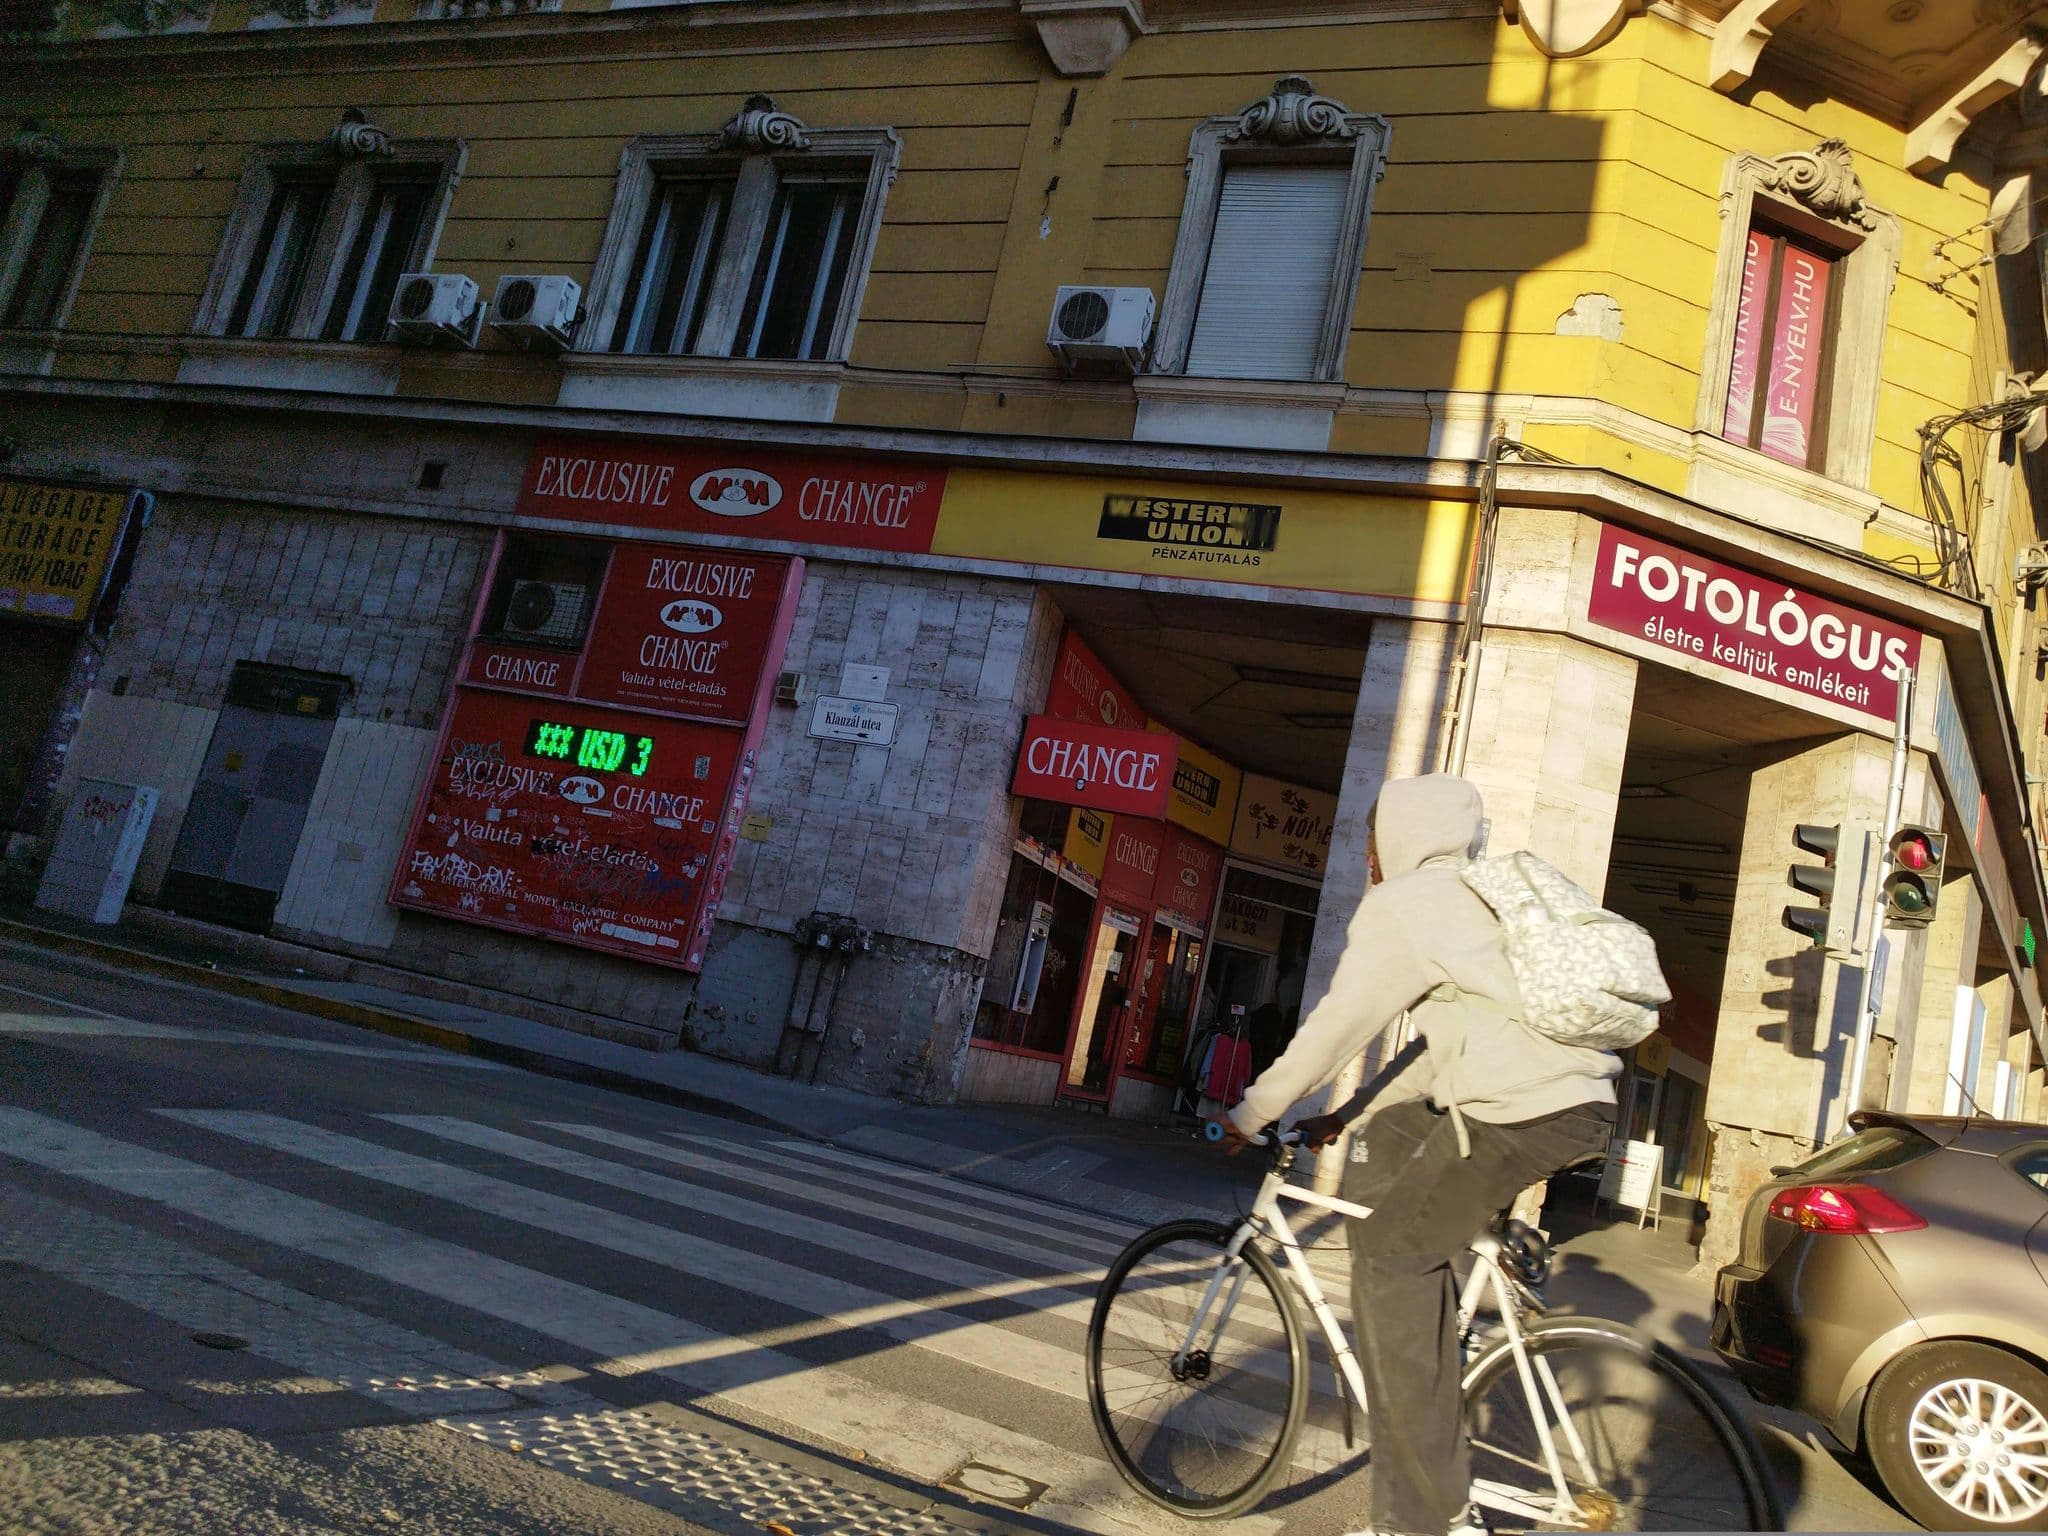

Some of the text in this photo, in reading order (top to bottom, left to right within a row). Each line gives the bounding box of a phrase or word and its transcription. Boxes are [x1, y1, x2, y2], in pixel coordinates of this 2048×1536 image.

[1779, 258, 1816, 415] E-NYELV.HU
[535, 456, 675, 507] EXCLUSIVE
[1, 517, 101, 557] TORAGE
[1147, 520, 1244, 547] UNION
[1152, 547, 1261, 566] PÉNZÁTUTALÁS
[646, 557, 755, 600] EXCLUSIVE
[1611, 543, 1909, 682] FOTOLÓGUS
[486, 654, 559, 687] CHANGE
[1643, 616, 1871, 706] életre keltjük emlékeit
[621, 671, 727, 697] Valuta vétel-eladás
[825, 711, 860, 729] Klauzál
[861, 716, 881, 731] utca
[577, 728, 626, 772] USD
[1028, 736, 1160, 791] CHANGE
[449, 756, 554, 796] EXCLUSIVE
[613, 784, 704, 823] CHANGE
[463, 818, 523, 846] Valuta
[1115, 832, 1159, 876] CHANGE
[523, 892, 558, 908] MONEY
[623, 913, 675, 932] COMPANY
